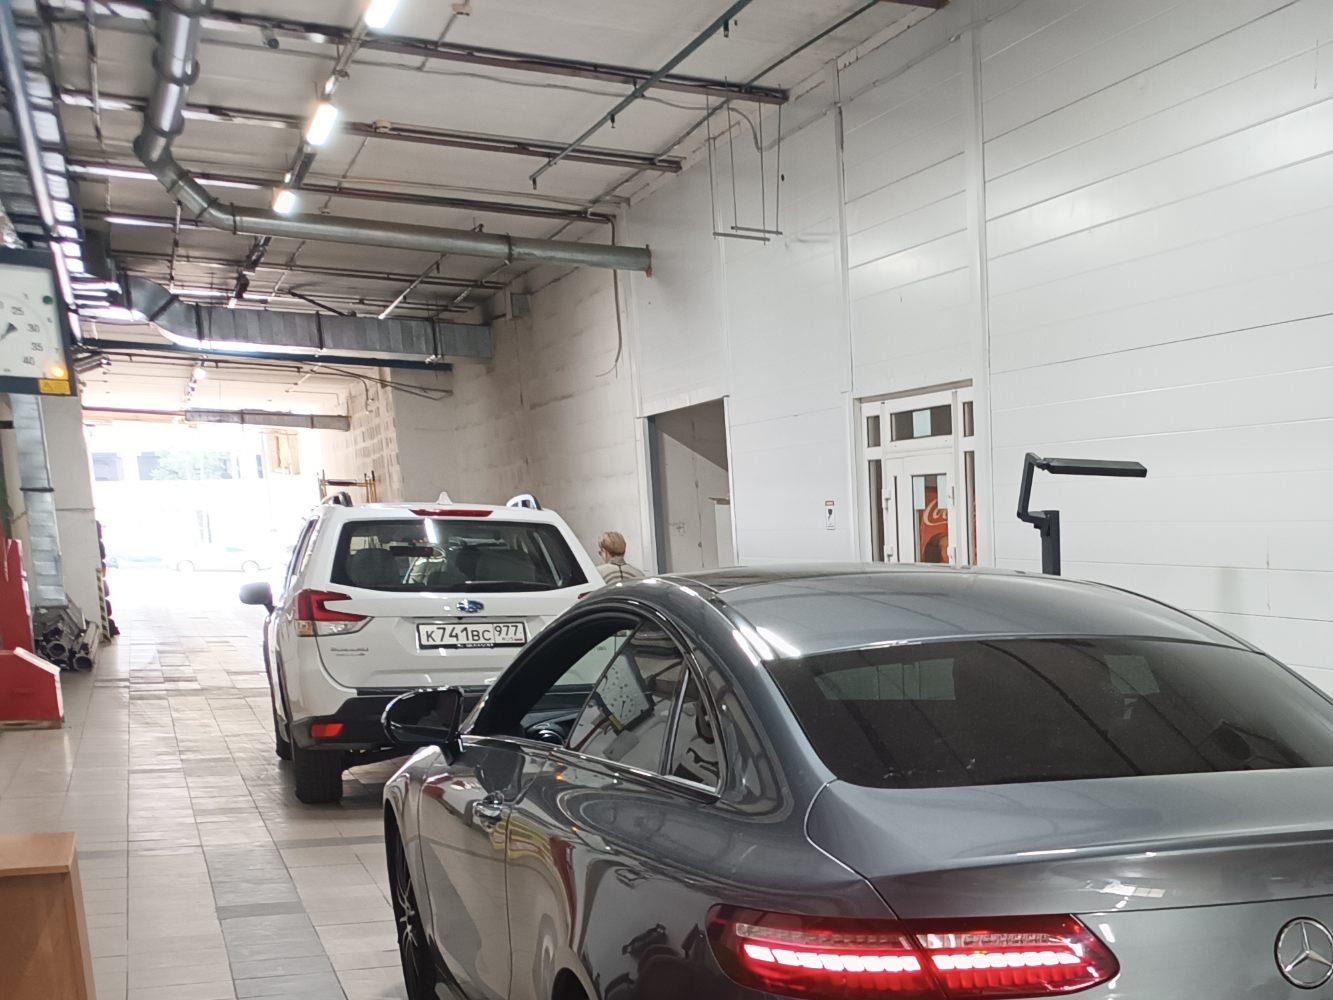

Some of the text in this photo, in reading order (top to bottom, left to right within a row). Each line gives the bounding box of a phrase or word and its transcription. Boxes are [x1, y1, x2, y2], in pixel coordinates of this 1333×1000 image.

[11, 306, 24, 315] 25
[27, 323, 40, 333] 30
[31, 342, 43, 351] 35
[494, 625, 519, 636] 977
